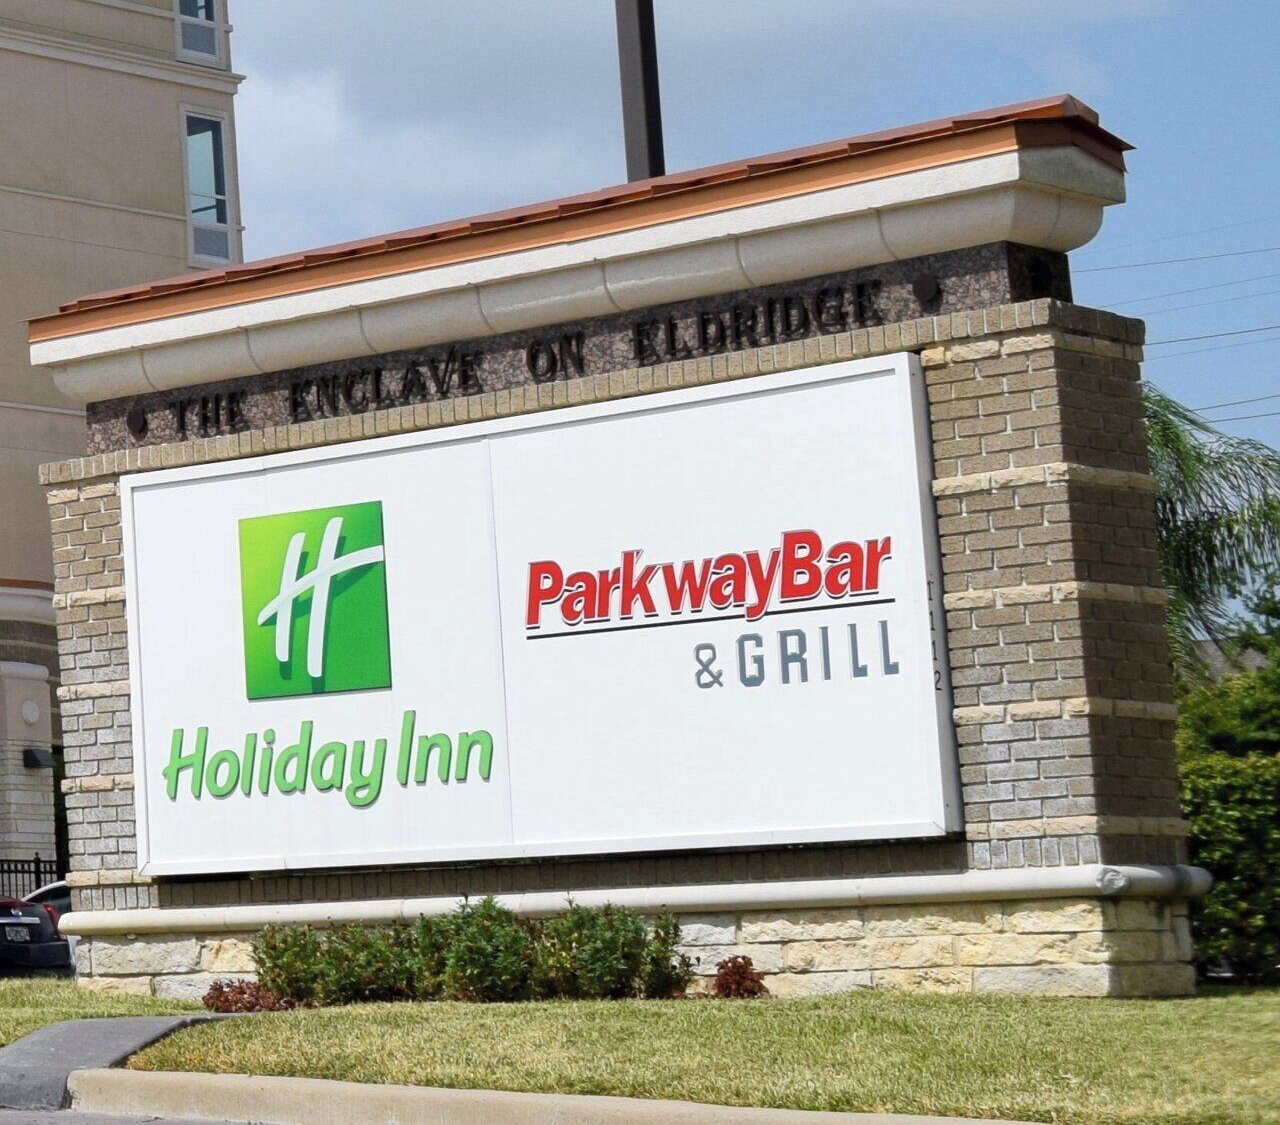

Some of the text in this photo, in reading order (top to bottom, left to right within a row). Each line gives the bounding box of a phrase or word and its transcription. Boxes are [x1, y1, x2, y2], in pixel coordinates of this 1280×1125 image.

[169, 278, 882, 438] THE ENCLAVE ON ELDRIDGE
[257, 516, 385, 678] H
[693, 620, 900, 690] & GRILL
[162, 709, 494, 808] Holiday Inn
